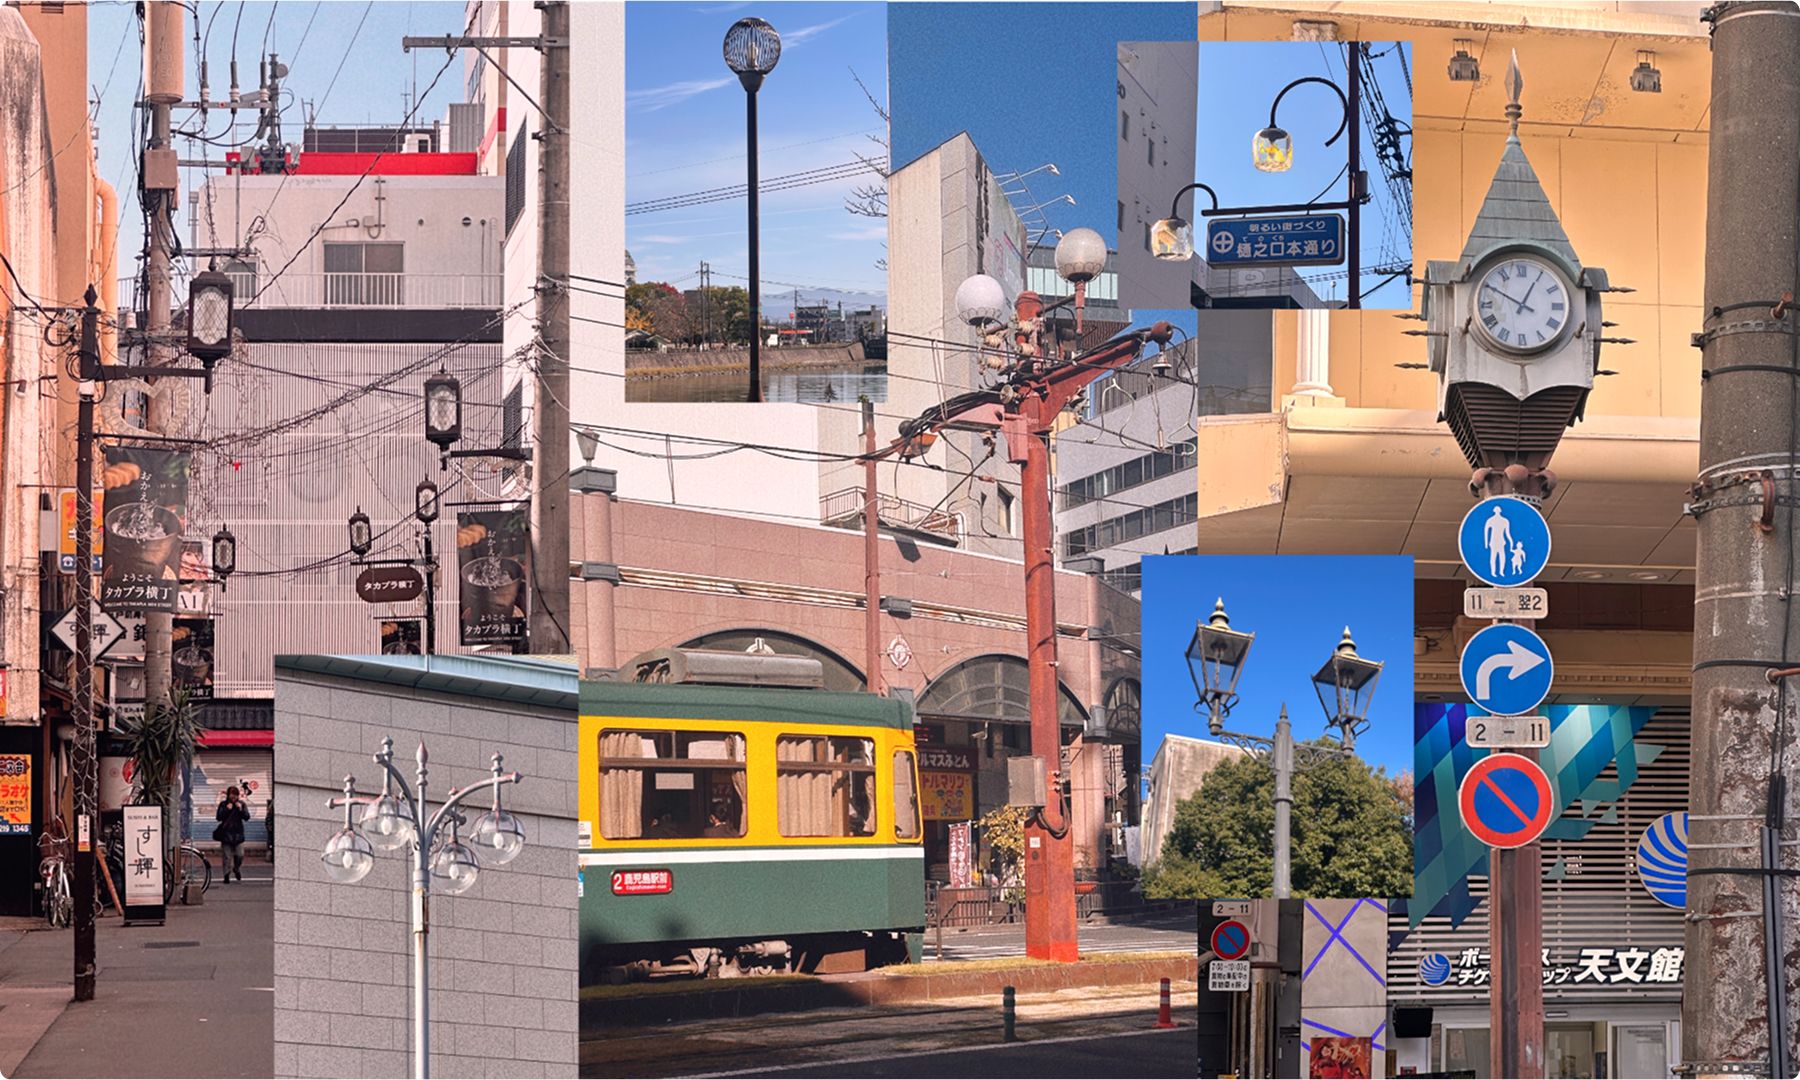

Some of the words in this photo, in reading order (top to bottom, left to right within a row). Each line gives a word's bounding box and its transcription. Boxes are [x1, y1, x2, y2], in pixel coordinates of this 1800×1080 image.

[1237, 238, 1335, 258] 樋之口本通り
[1498, 267, 1510, 282] XI
[1546, 284, 1559, 294] II
[1552, 302, 1564, 310] III
[1518, 333, 1527, 346] VI
[1536, 330, 1546, 342] V
[122, 573, 154, 583] ようこそ
[1471, 595, 1482, 610] 11
[1518, 595, 1543, 610] 翌2
[1475, 723, 1486, 741] 2
[1530, 723, 1543, 741] 11
[613, 873, 622, 890] 2
[1217, 904, 1224, 913] 2
[1240, 904, 1249, 913] 11
[1573, 947, 1685, 983] 天文館
